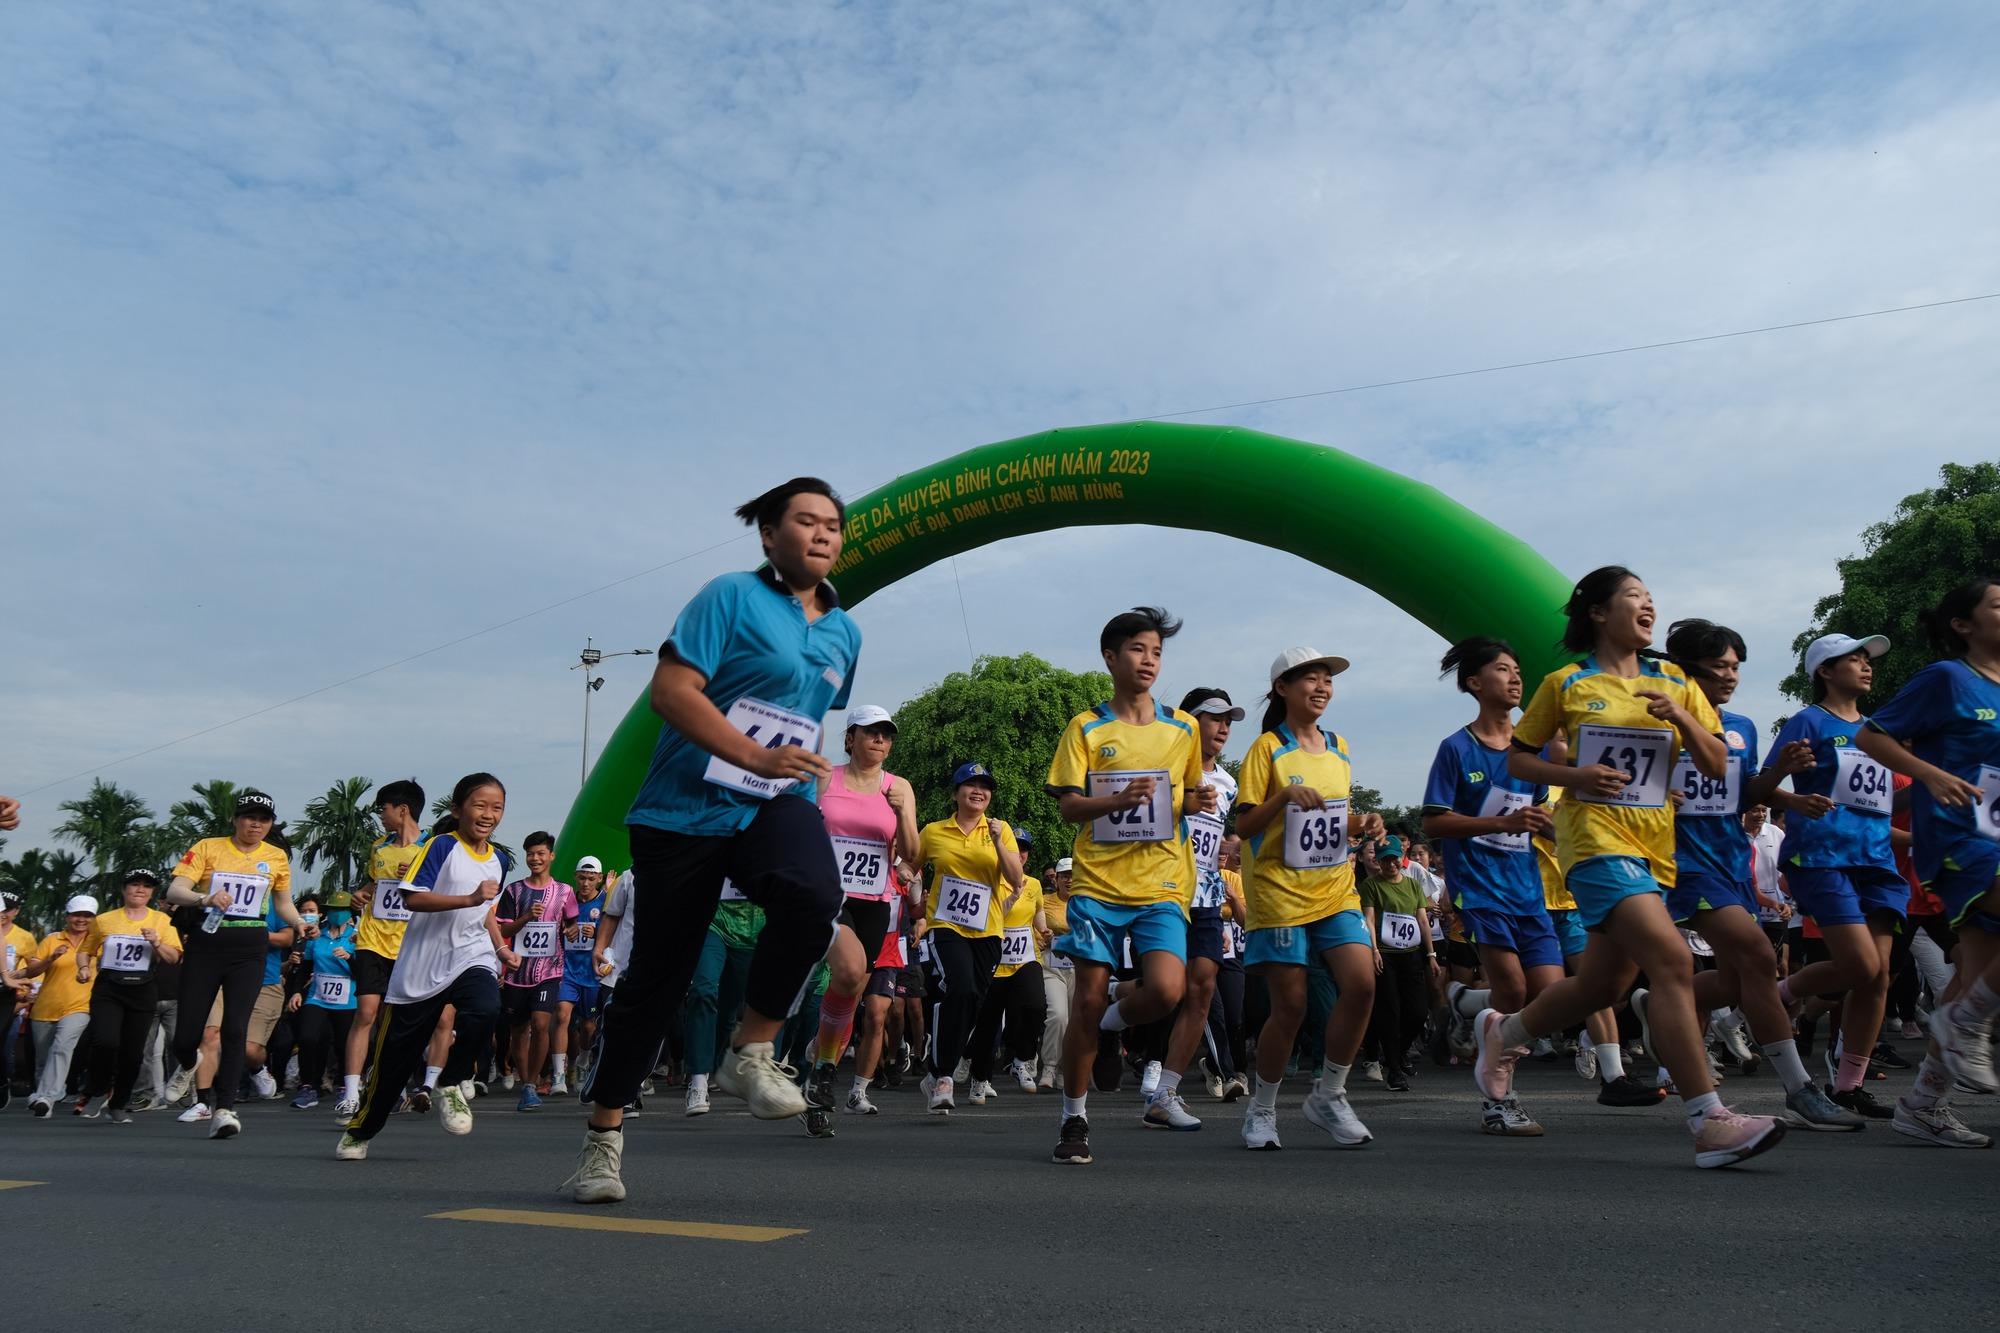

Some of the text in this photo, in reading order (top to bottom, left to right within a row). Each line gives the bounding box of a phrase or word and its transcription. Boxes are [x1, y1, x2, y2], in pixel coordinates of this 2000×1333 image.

[871, 498, 895, 528] DÃ
[898, 478, 951, 516] HUYỆN
[955, 467, 991, 496] BÌNH
[996, 452, 1056, 486] CHÁNH
[1061, 446, 1103, 475] NĂM
[1108, 449, 1150, 475] 2023
[864, 527, 905, 556] TRÌNH
[904, 513, 925, 538] VỀ
[926, 511, 951, 532] ĐỊA
[952, 499, 991, 523] DANH
[992, 491, 1024, 514] LỊCH
[1026, 480, 1046, 505] SỬ
[1050, 485, 1078, 502] ANH
[1083, 478, 1124, 500] HÙNG
[1597, 746, 1656, 786] 637
[1849, 763, 1887, 797] 634
[742, 774, 770, 791] Nam
[1684, 771, 1728, 800] 584
[1193, 829, 1218, 859] 587
[1300, 816, 1341, 852] 635
[842, 851, 881, 878] 225
[946, 888, 980, 917] 245
[523, 931, 549, 949] 622
[1391, 921, 1415, 941] 149
[115, 942, 144, 962] 128
[1003, 936, 1028, 956] 247
[323, 981, 343, 996] 179
[540, 990, 548, 1002] 11
